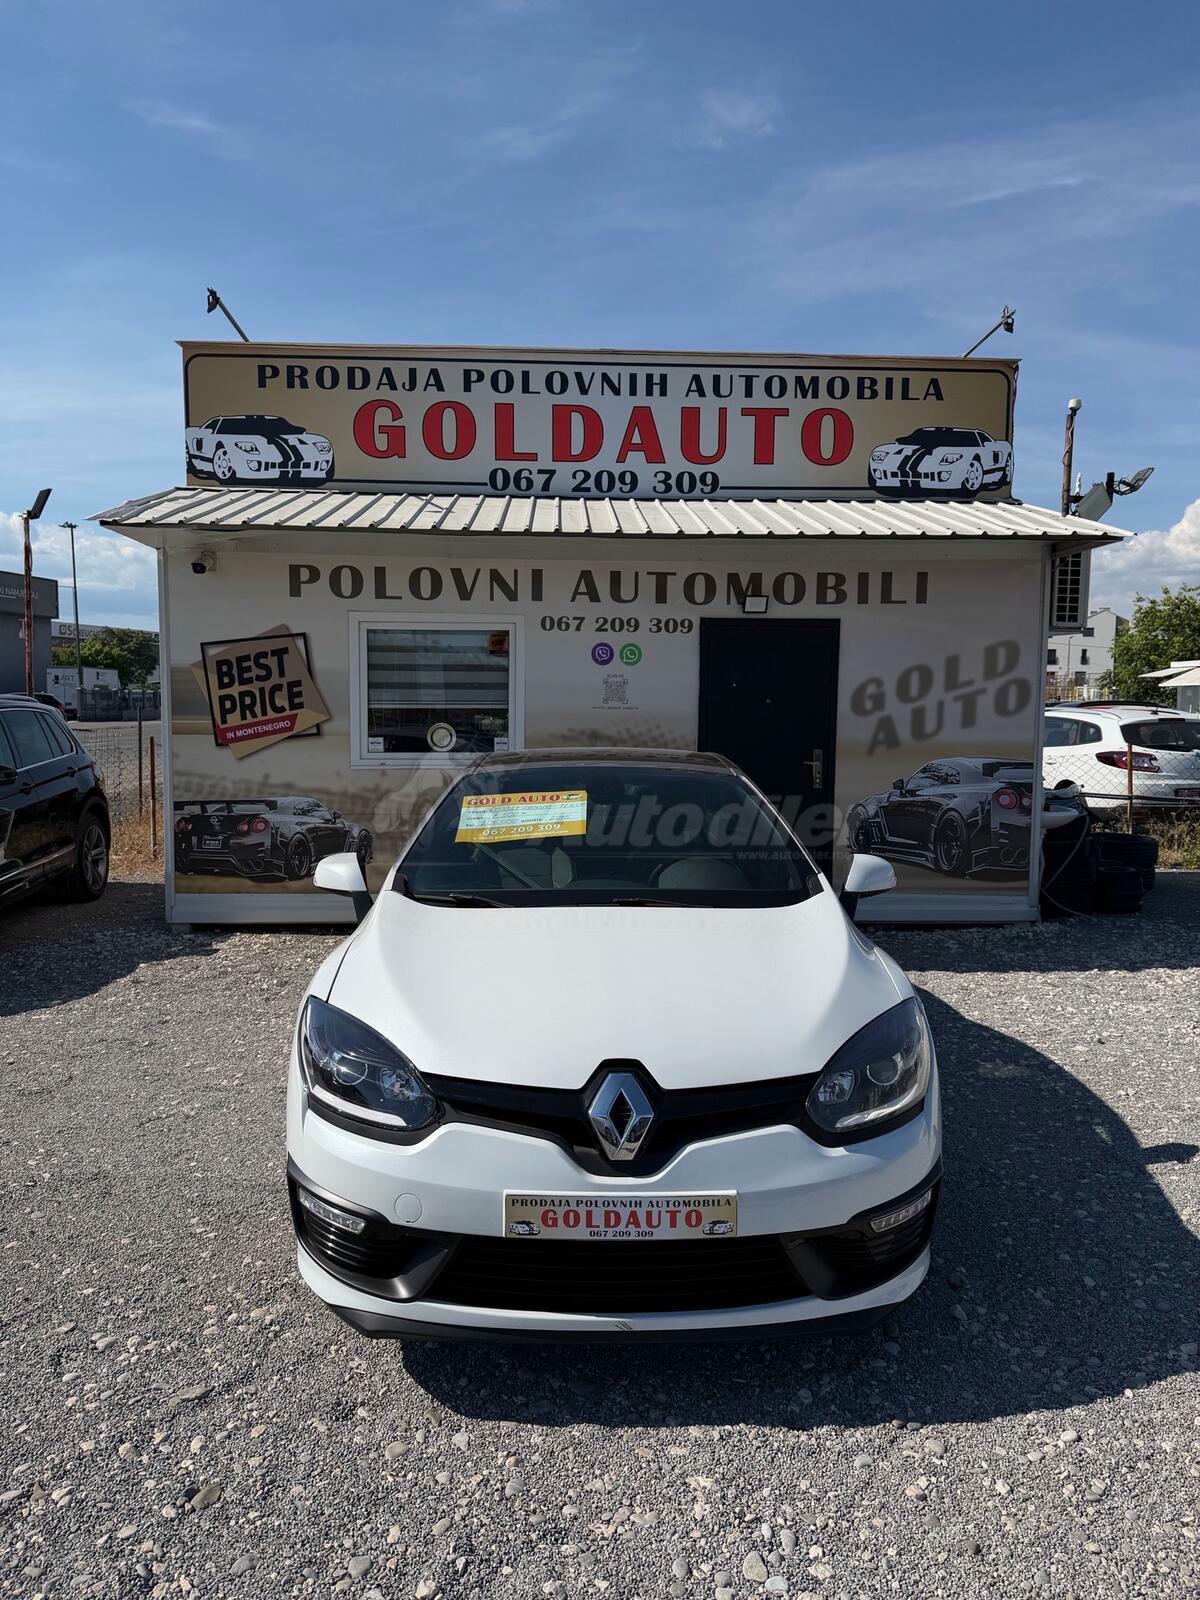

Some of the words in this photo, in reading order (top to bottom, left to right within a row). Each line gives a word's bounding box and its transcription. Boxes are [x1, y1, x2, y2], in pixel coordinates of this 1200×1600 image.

[257, 363, 444, 394] PRODAJA
[463, 368, 668, 398] POLOVNIH
[686, 373, 946, 402] AUTOMOBILA
[353, 398, 855, 467] GOLDAUTO
[489, 467, 557, 494] 067
[571, 468, 639, 495] 209
[652, 469, 721, 496] 309
[289, 565, 544, 602] POLOVNI
[570, 569, 930, 606] AUTOMOBILI
[540, 615, 585, 632] 067
[595, 616, 640, 633] 209
[649, 617, 694, 634] 309
[216, 646, 289, 690] BEST
[850, 640, 1021, 717] GOLD
[218, 679, 305, 725] PRICE
[226, 731, 235, 739] IN
[236, 720, 291, 737] MONTENEGRO
[866, 677, 1032, 757] AUTO
[467, 796, 512, 806] GOLD
[518, 794, 561, 804] AUTO
[482, 828, 506, 836] 067
[537, 824, 560, 832] 309
[511, 1198, 571, 1208] PRODAJA
[575, 1199, 642, 1209] POLOVNIH
[647, 1198, 732, 1209] AUTOMOBILA
[540, 1209, 703, 1229] GOLDAUTO
[589, 1230, 610, 1238] 067
[612, 1230, 631, 1238] 209
[634, 1230, 654, 1238] 309
